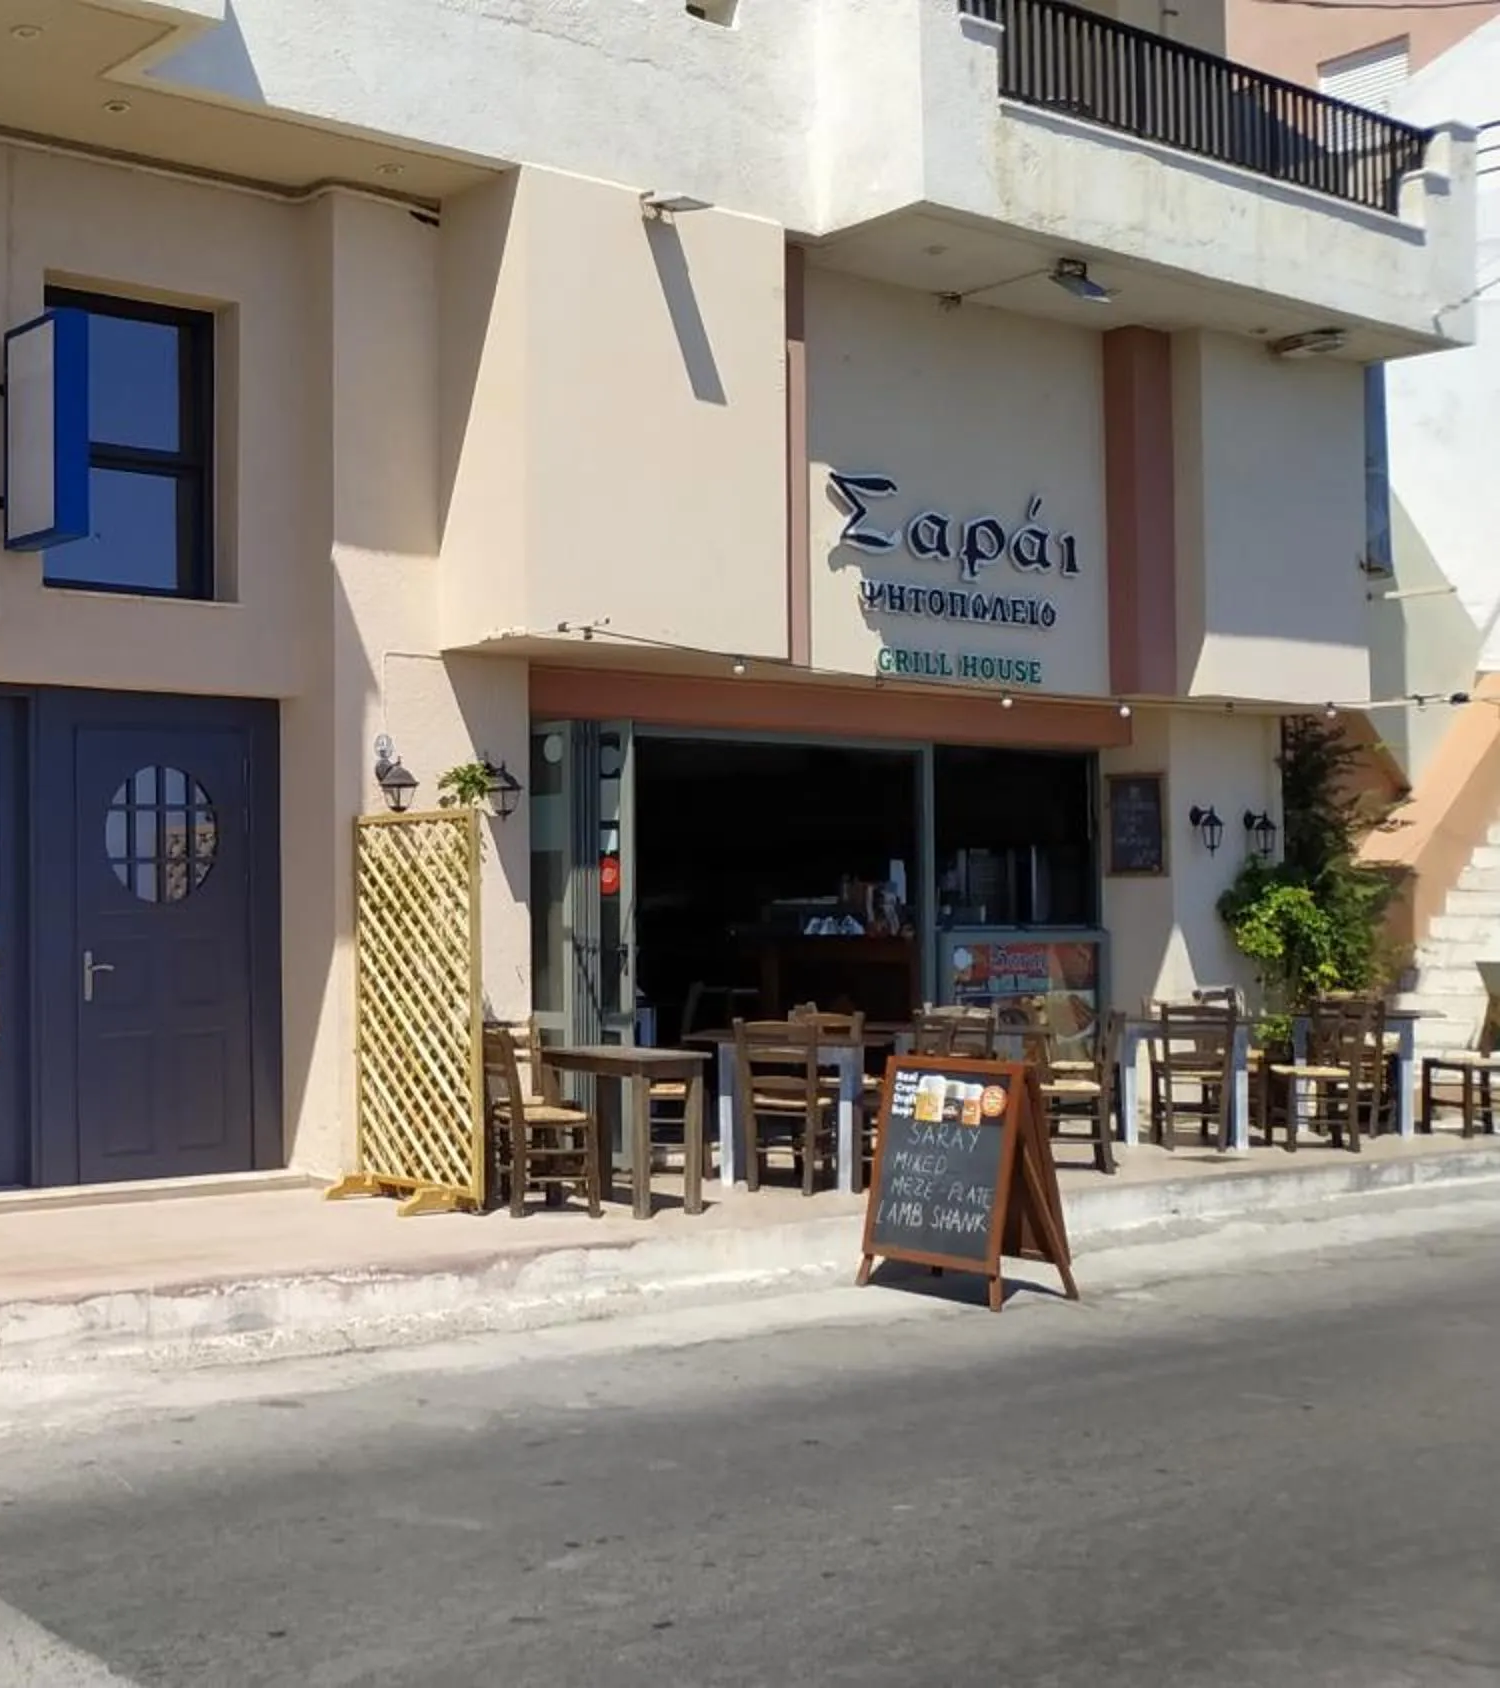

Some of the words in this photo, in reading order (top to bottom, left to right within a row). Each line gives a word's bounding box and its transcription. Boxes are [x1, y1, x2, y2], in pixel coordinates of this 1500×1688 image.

[827, 470, 1082, 580] Σαράι
[858, 580, 1057, 629] ΨΗΤΟΠΩΛΕΙΟ
[877, 648, 953, 677] GRILL
[962, 654, 1043, 684] HOUSE
[907, 1122, 981, 1153] SARAY
[892, 1151, 948, 1176] MIXED
[890, 1175, 933, 1201] MEZE
[947, 1181, 994, 1212] PLATE
[876, 1198, 923, 1227] LAMB
[930, 1204, 988, 1233] SHANK
